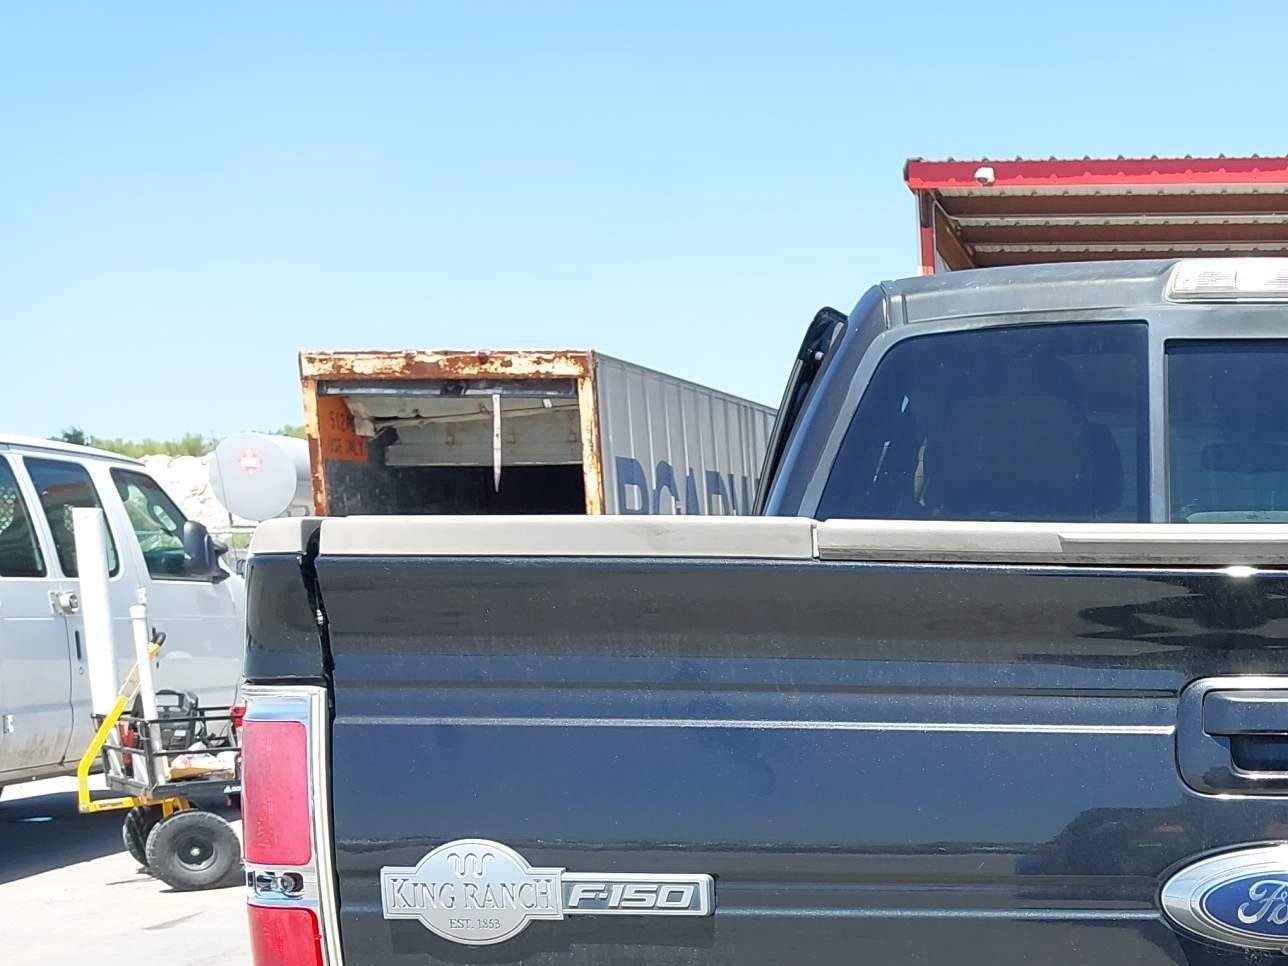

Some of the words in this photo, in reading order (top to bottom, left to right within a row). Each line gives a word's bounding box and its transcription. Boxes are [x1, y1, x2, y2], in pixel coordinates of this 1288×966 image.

[390, 877, 457, 911] KING
[463, 878, 554, 912] RANCH
[568, 884, 695, 909] F-150
[449, 918, 475, 930] EST.
[478, 918, 501, 930] 1853
